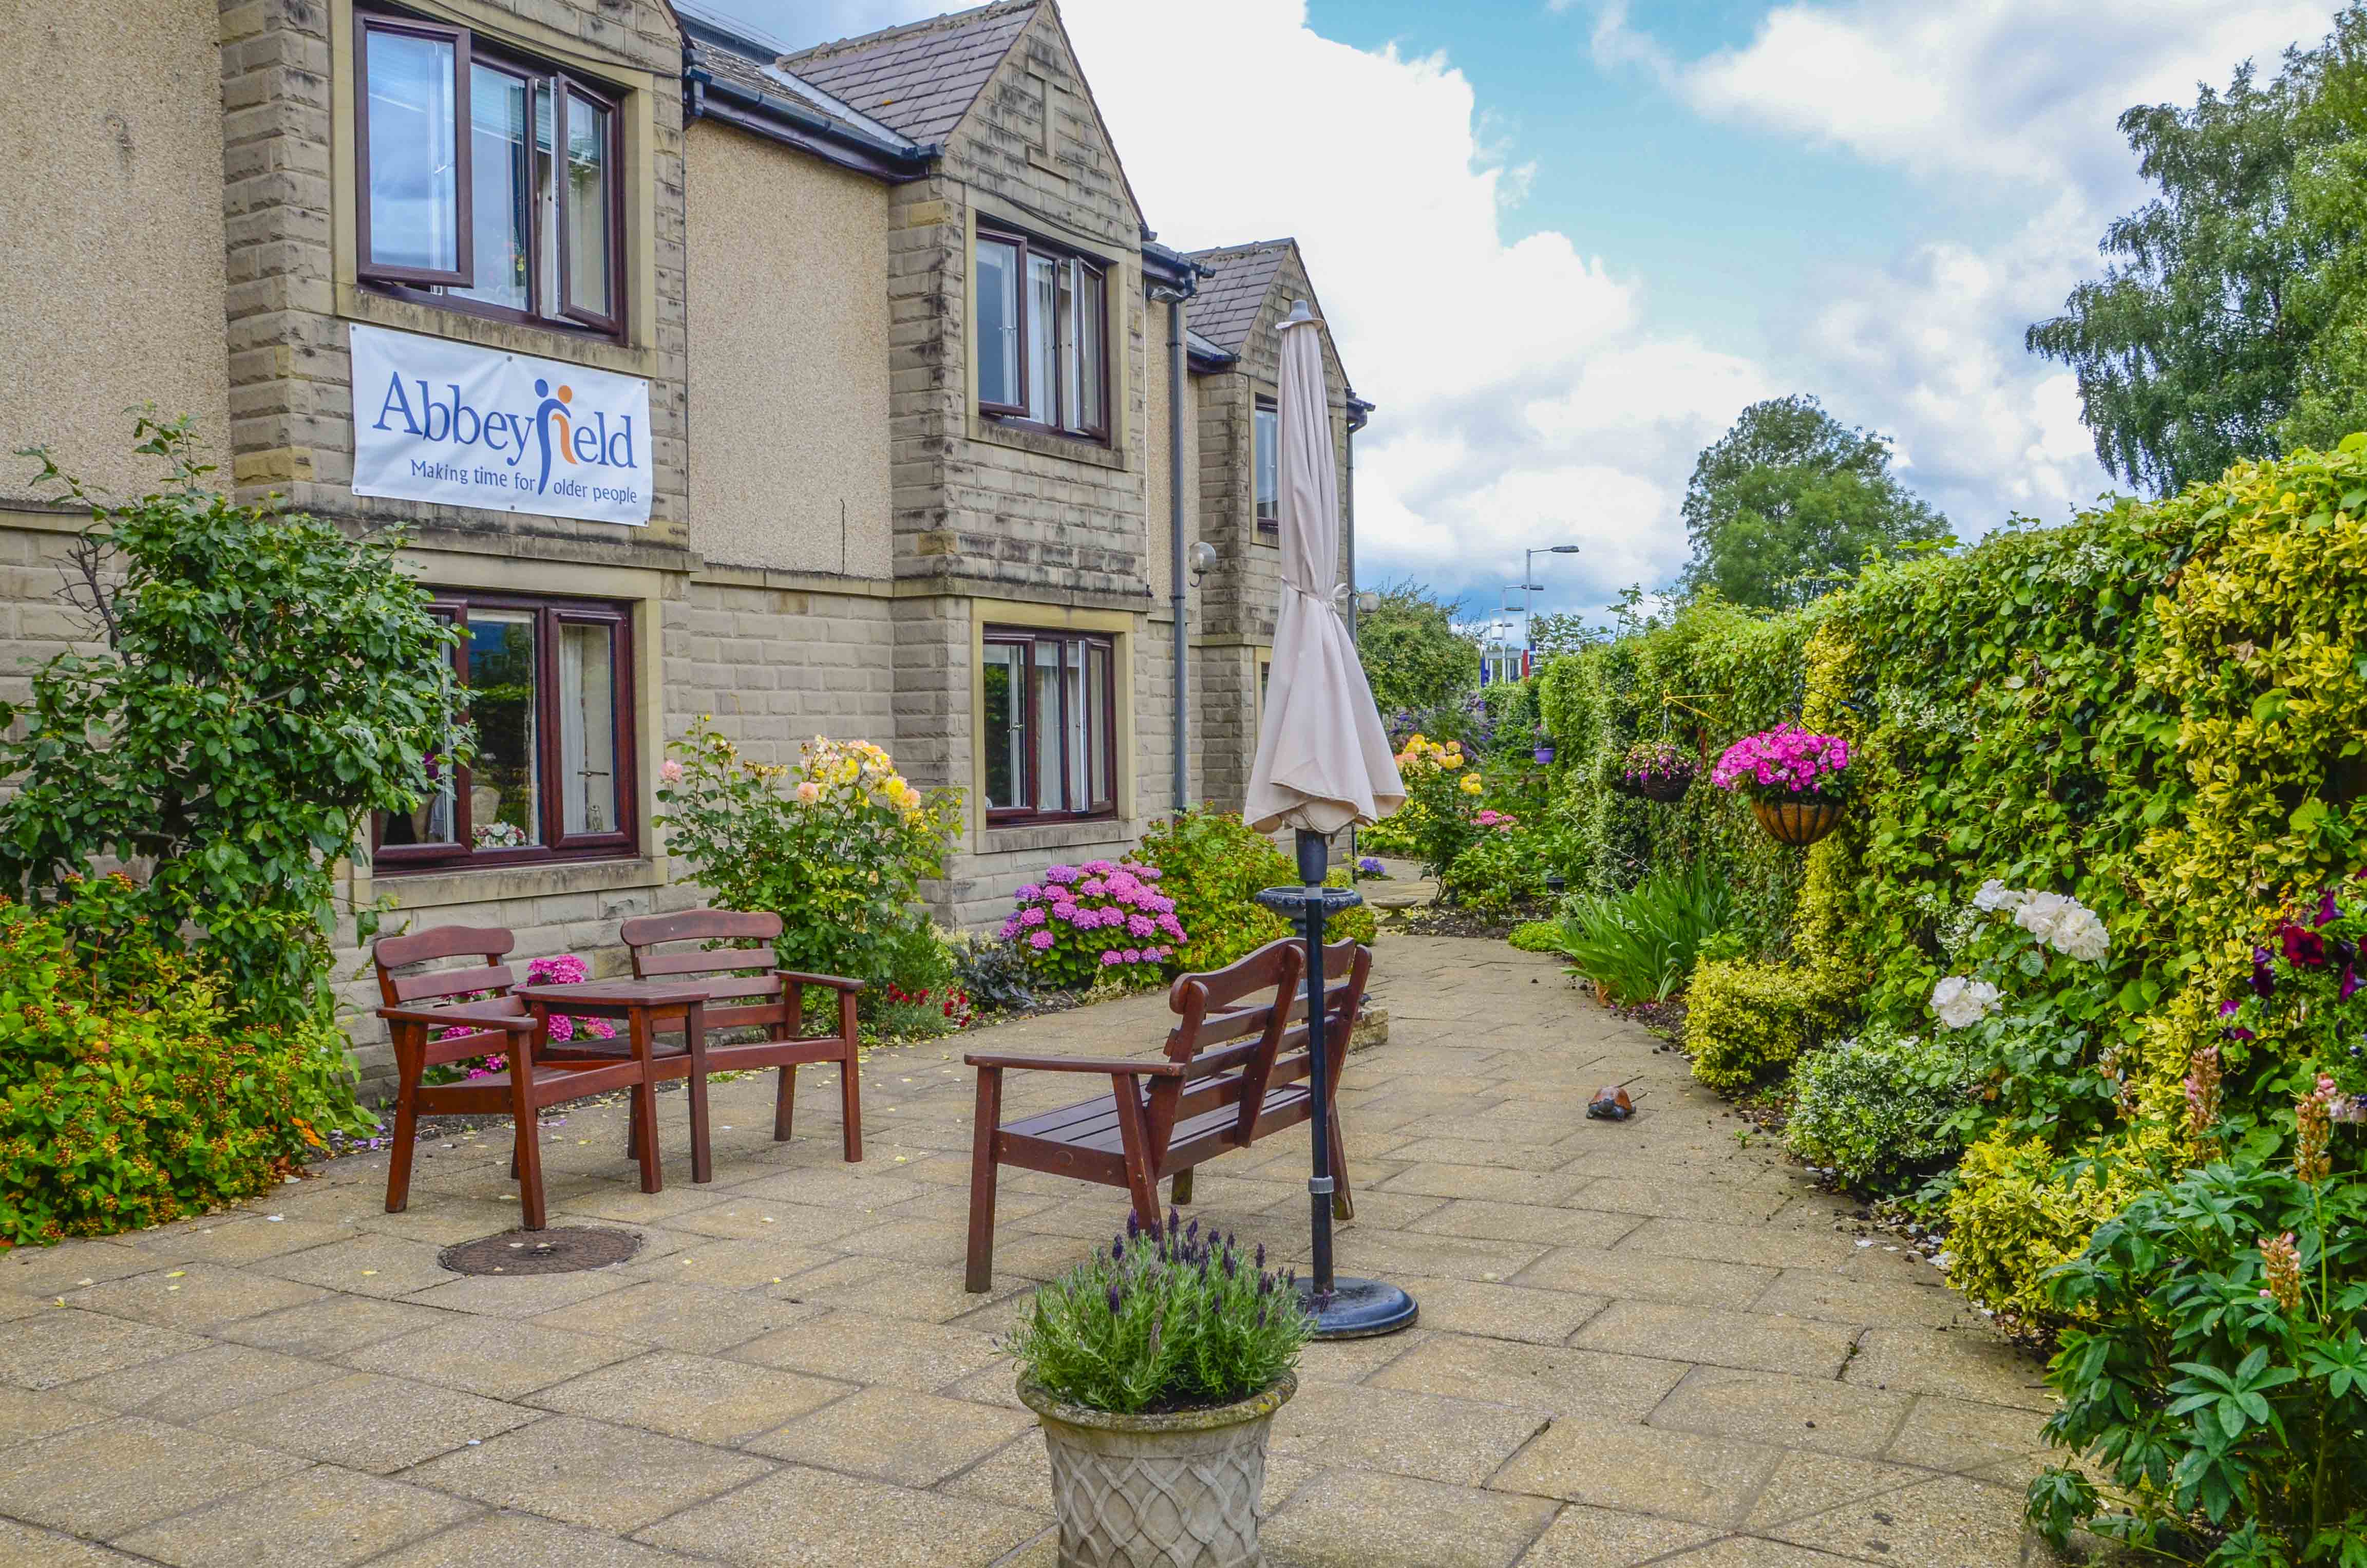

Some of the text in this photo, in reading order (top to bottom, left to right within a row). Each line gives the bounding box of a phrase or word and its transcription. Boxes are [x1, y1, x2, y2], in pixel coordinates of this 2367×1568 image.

[372, 371, 637, 496] Abbeyfield
[411, 459, 637, 505] Making time for older people
